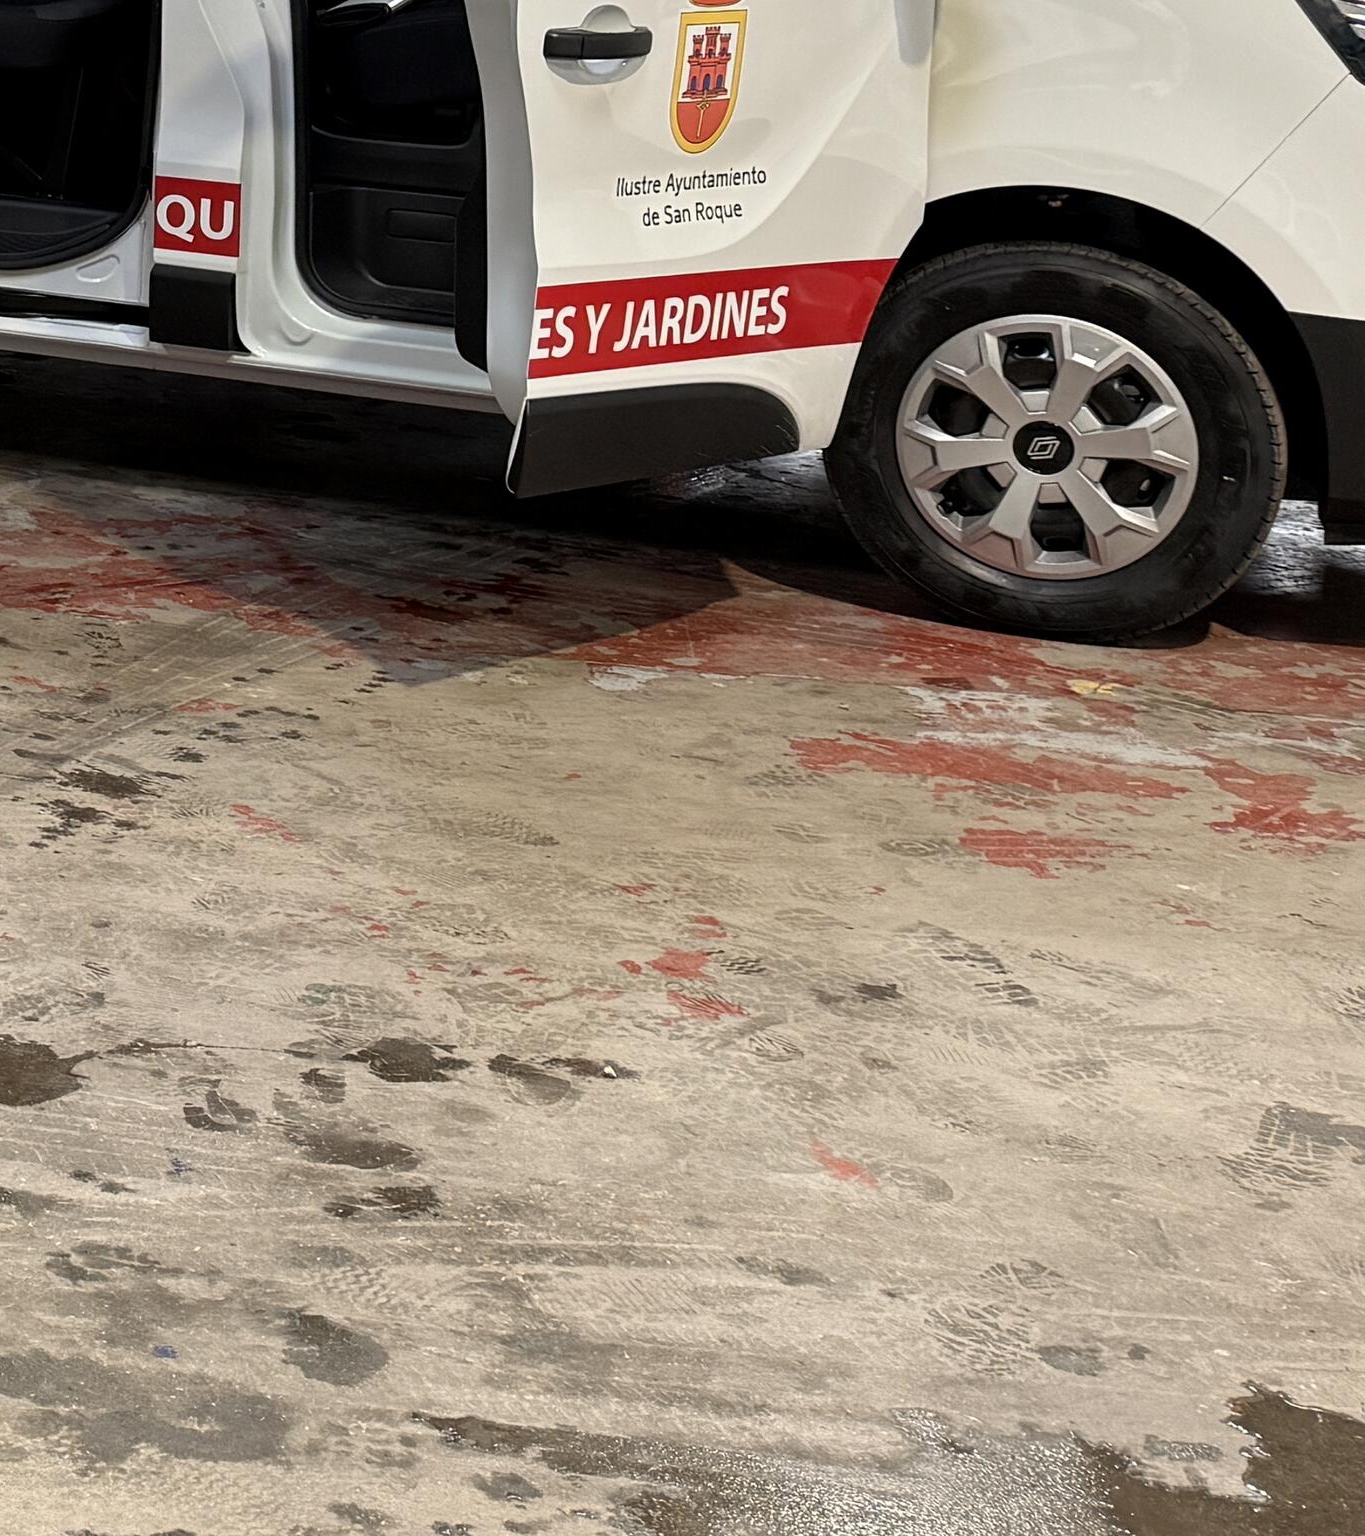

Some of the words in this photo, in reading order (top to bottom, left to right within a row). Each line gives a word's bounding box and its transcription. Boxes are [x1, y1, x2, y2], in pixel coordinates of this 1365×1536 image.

[616, 175, 661, 197] Ilustre
[665, 166, 767, 197] Ayuntamiento
[156, 194, 235, 243] QU
[642, 207, 660, 227] de
[664, 205, 691, 225] San
[695, 202, 743, 224] Roque
[529, 305, 577, 360] ES
[585, 303, 611, 354] Y
[612, 286, 789, 353] JARDINES
